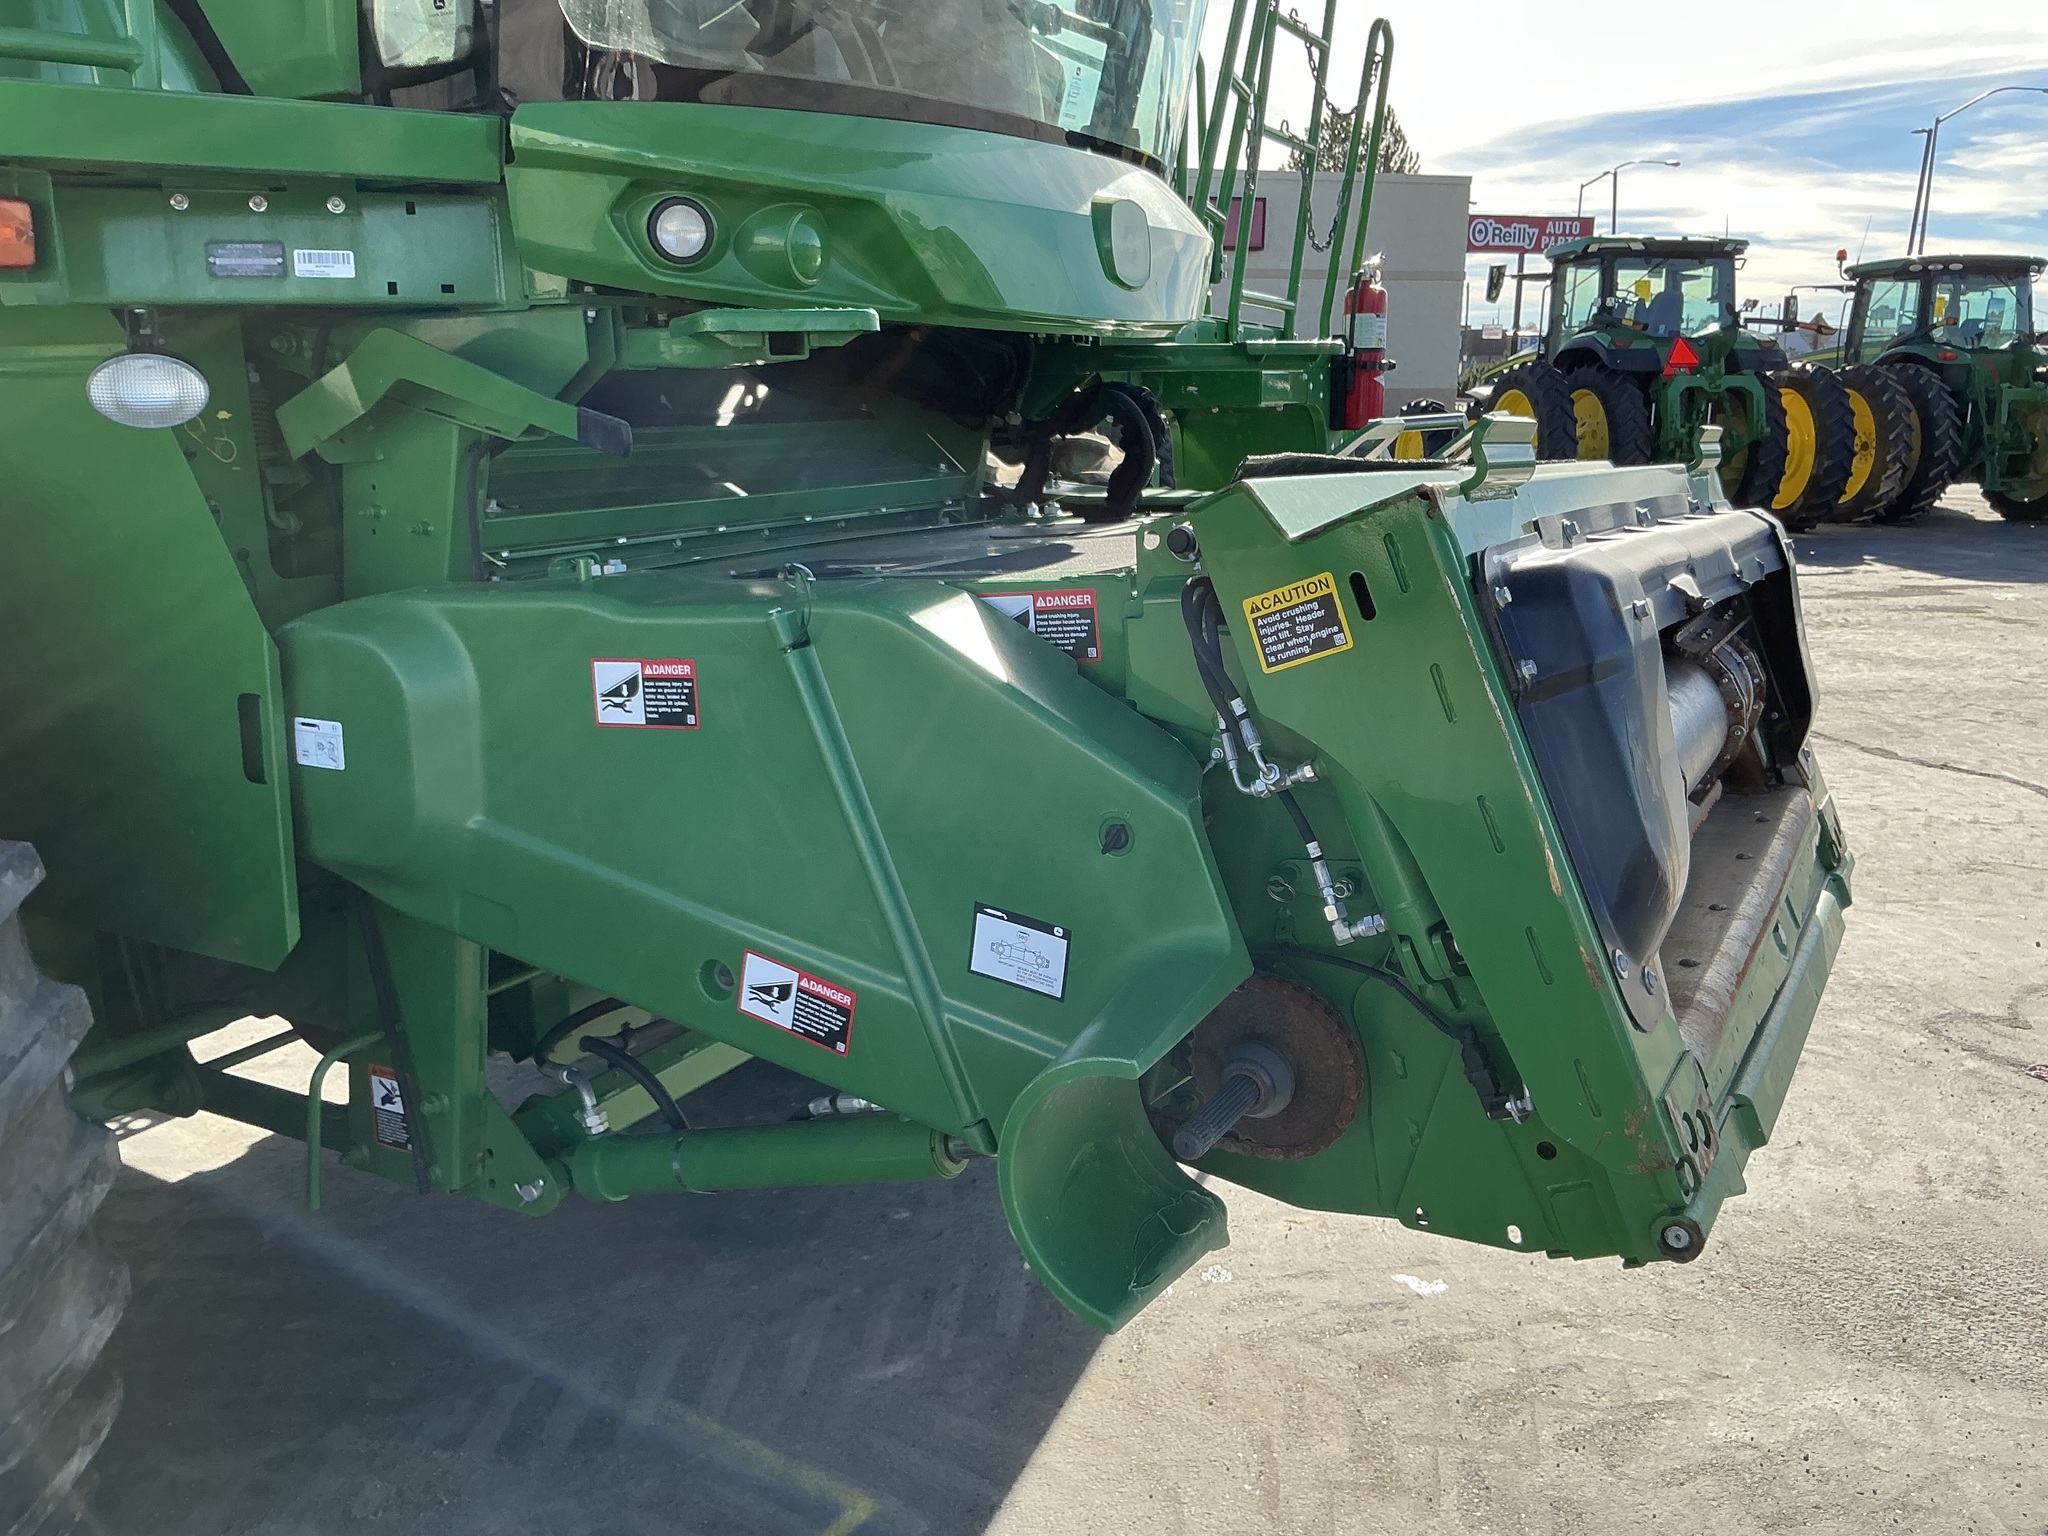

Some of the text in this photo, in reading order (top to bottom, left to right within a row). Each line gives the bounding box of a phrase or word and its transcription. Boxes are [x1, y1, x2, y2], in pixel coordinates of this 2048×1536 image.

[1471, 220, 1538, 248] O'Reilly
[1546, 221, 1580, 234] AUTO
[1542, 236, 1581, 248] PAR
[1046, 595, 1091, 606] DANGER
[1261, 577, 1330, 609] CAUTION
[1257, 601, 1318, 626] Avoid crushing
[1259, 609, 1325, 635] injuries. Header
[1263, 623, 1314, 644] can tilt. Stay
[1266, 626, 1338, 653] clear when engine
[1268, 645, 1311, 662] is running.
[653, 665, 691, 675] DANGER
[809, 981, 851, 1005] DANGER
